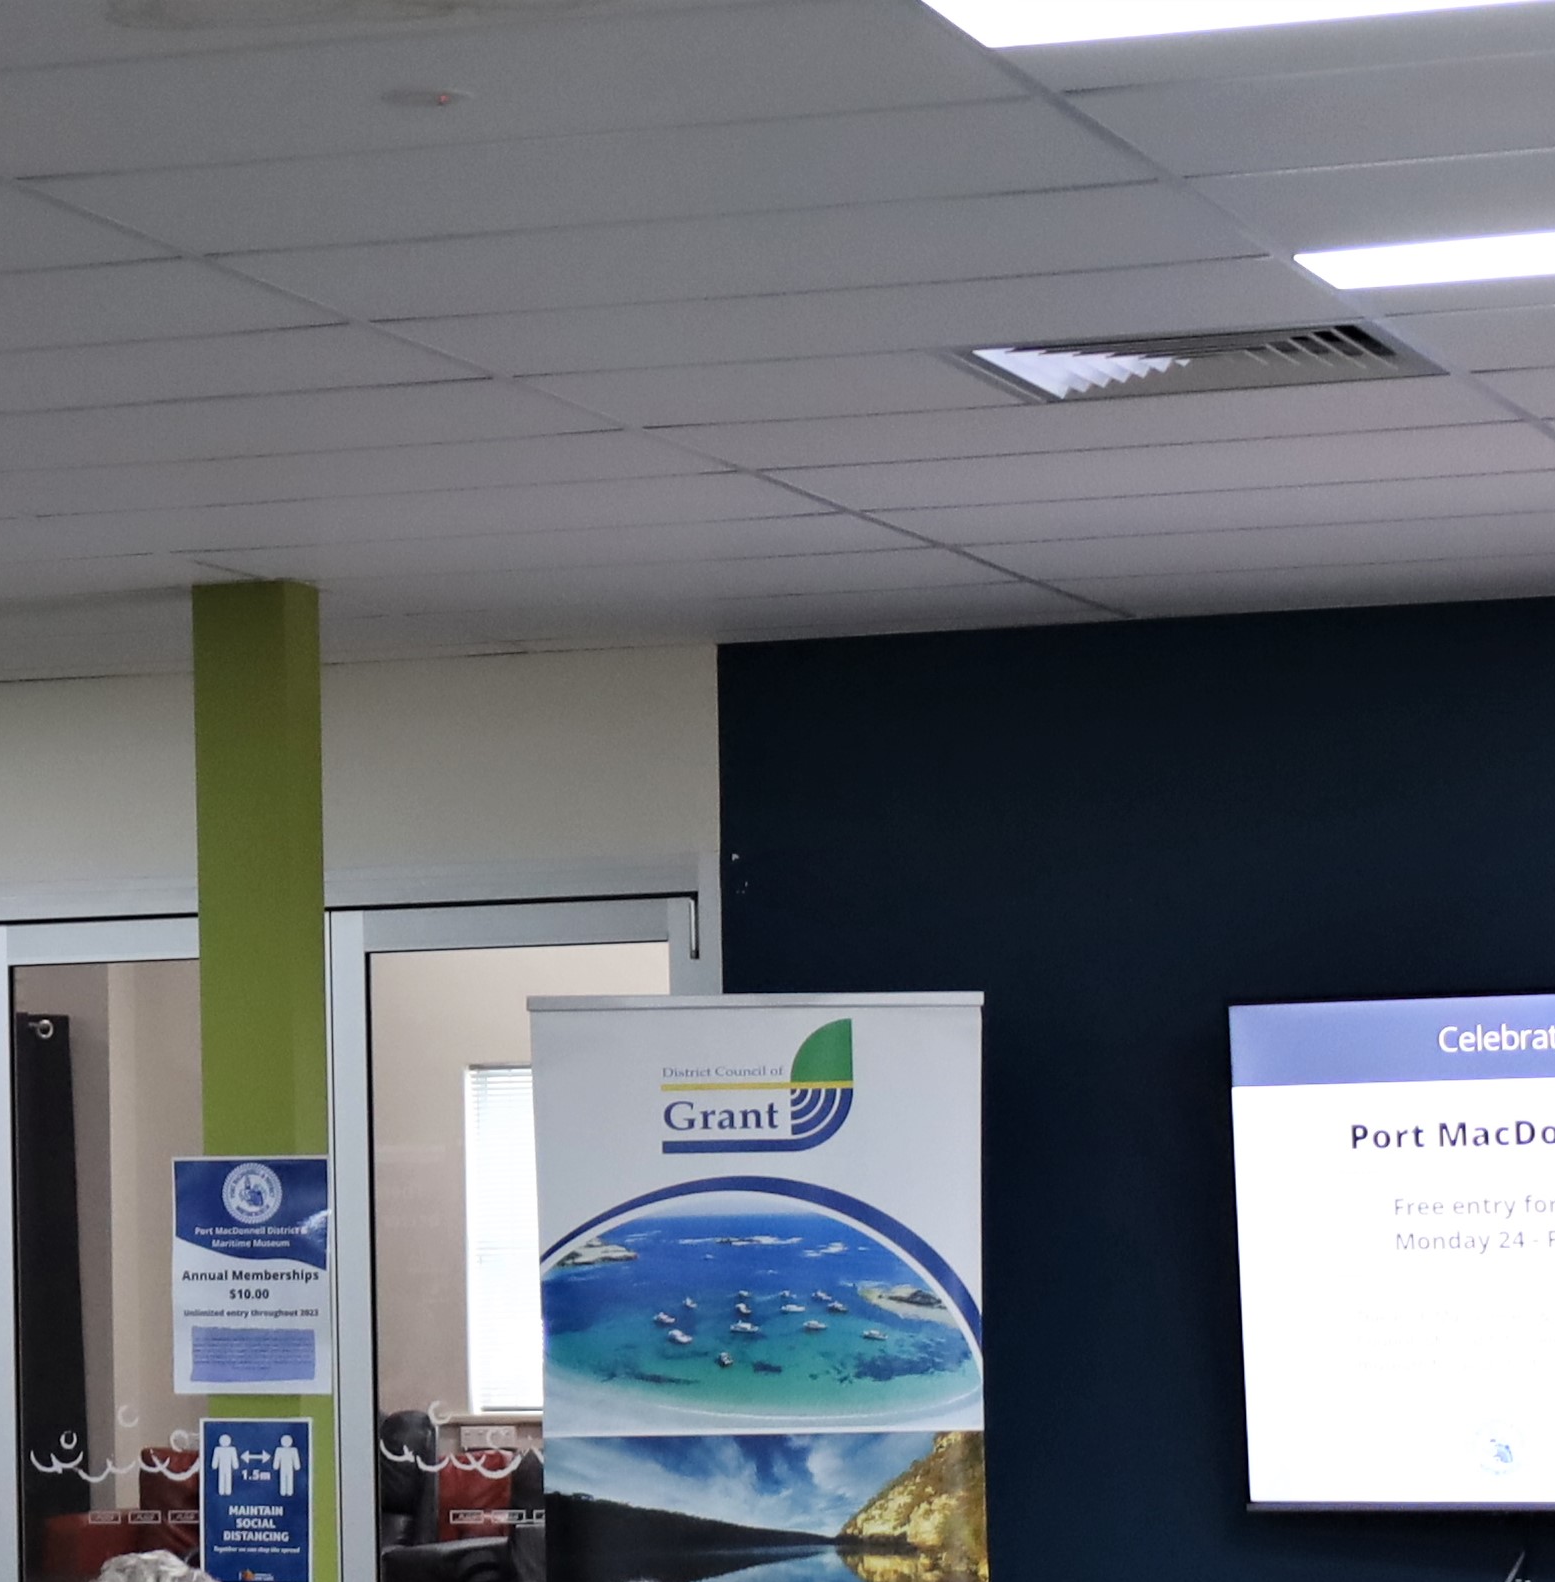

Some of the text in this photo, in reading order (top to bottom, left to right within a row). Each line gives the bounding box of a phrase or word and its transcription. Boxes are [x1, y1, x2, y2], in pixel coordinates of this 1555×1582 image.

[662, 1065, 784, 1078] District Council of
[664, 1101, 779, 1131] Grant
[1351, 1124, 1425, 1149] Port
[1394, 1198, 1444, 1215] Free
[1453, 1198, 1516, 1219] entry
[194, 1226, 213, 1235] Port
[215, 1226, 266, 1235] MacDonnell
[211, 1239, 290, 1248] Maritime Museum
[1396, 1231, 1491, 1254] Monday
[1499, 1231, 1525, 1249] 24
[182, 1270, 319, 1284] Annual Memberships
[229, 1288, 269, 1300] $10.00
[184, 1309, 224, 1317] Unlimited
[226, 1310, 249, 1319] entry
[251, 1309, 298, 1319] throughout
[242, 1470, 271, 1481] 1.5m
[229, 1505, 284, 1516] MAINTAIN
[236, 1518, 276, 1529] SOCIAL
[223, 1531, 289, 1542] DISTANCING
